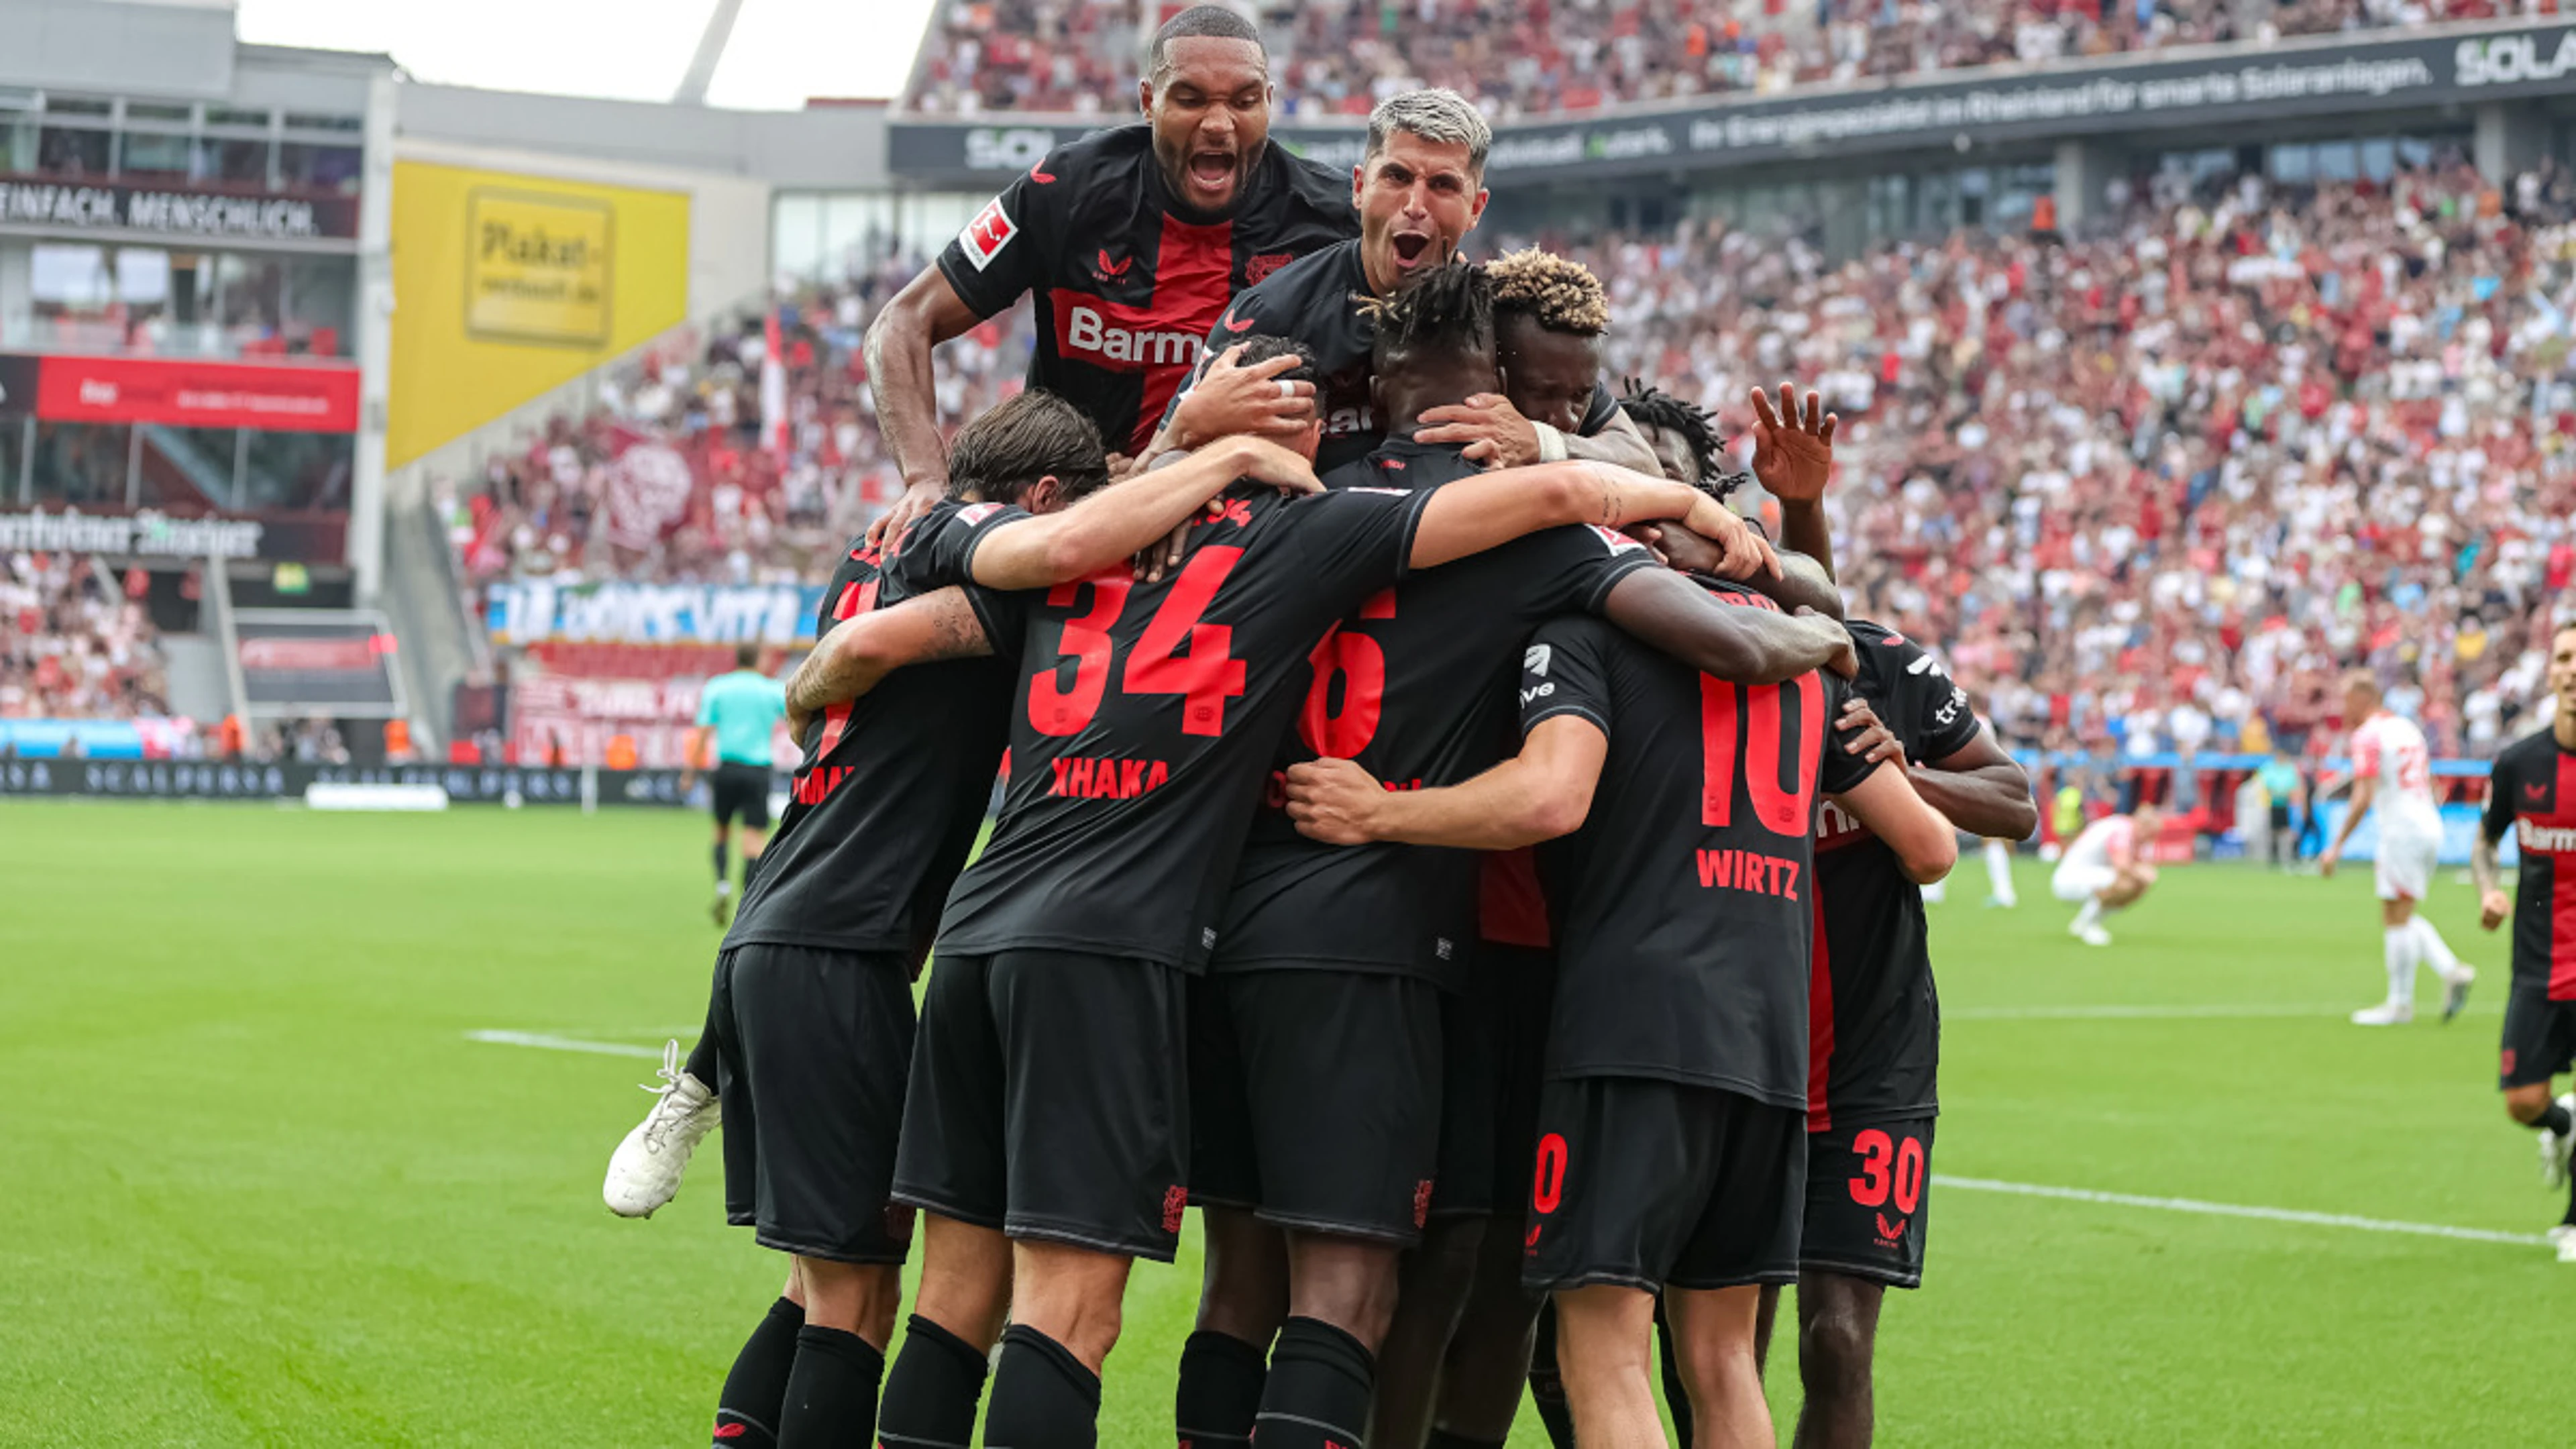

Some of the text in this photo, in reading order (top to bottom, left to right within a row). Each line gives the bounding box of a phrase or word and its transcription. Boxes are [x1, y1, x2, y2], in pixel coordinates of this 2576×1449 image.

[128, 191, 320, 237] MENSCHLICH.
[1028, 545, 1246, 737] 34
[1046, 758, 1169, 800] XHAKA
[1700, 668, 1825, 837] 10
[1696, 849, 1799, 902] WIRTZ
[1848, 1129, 1924, 1214] 30
